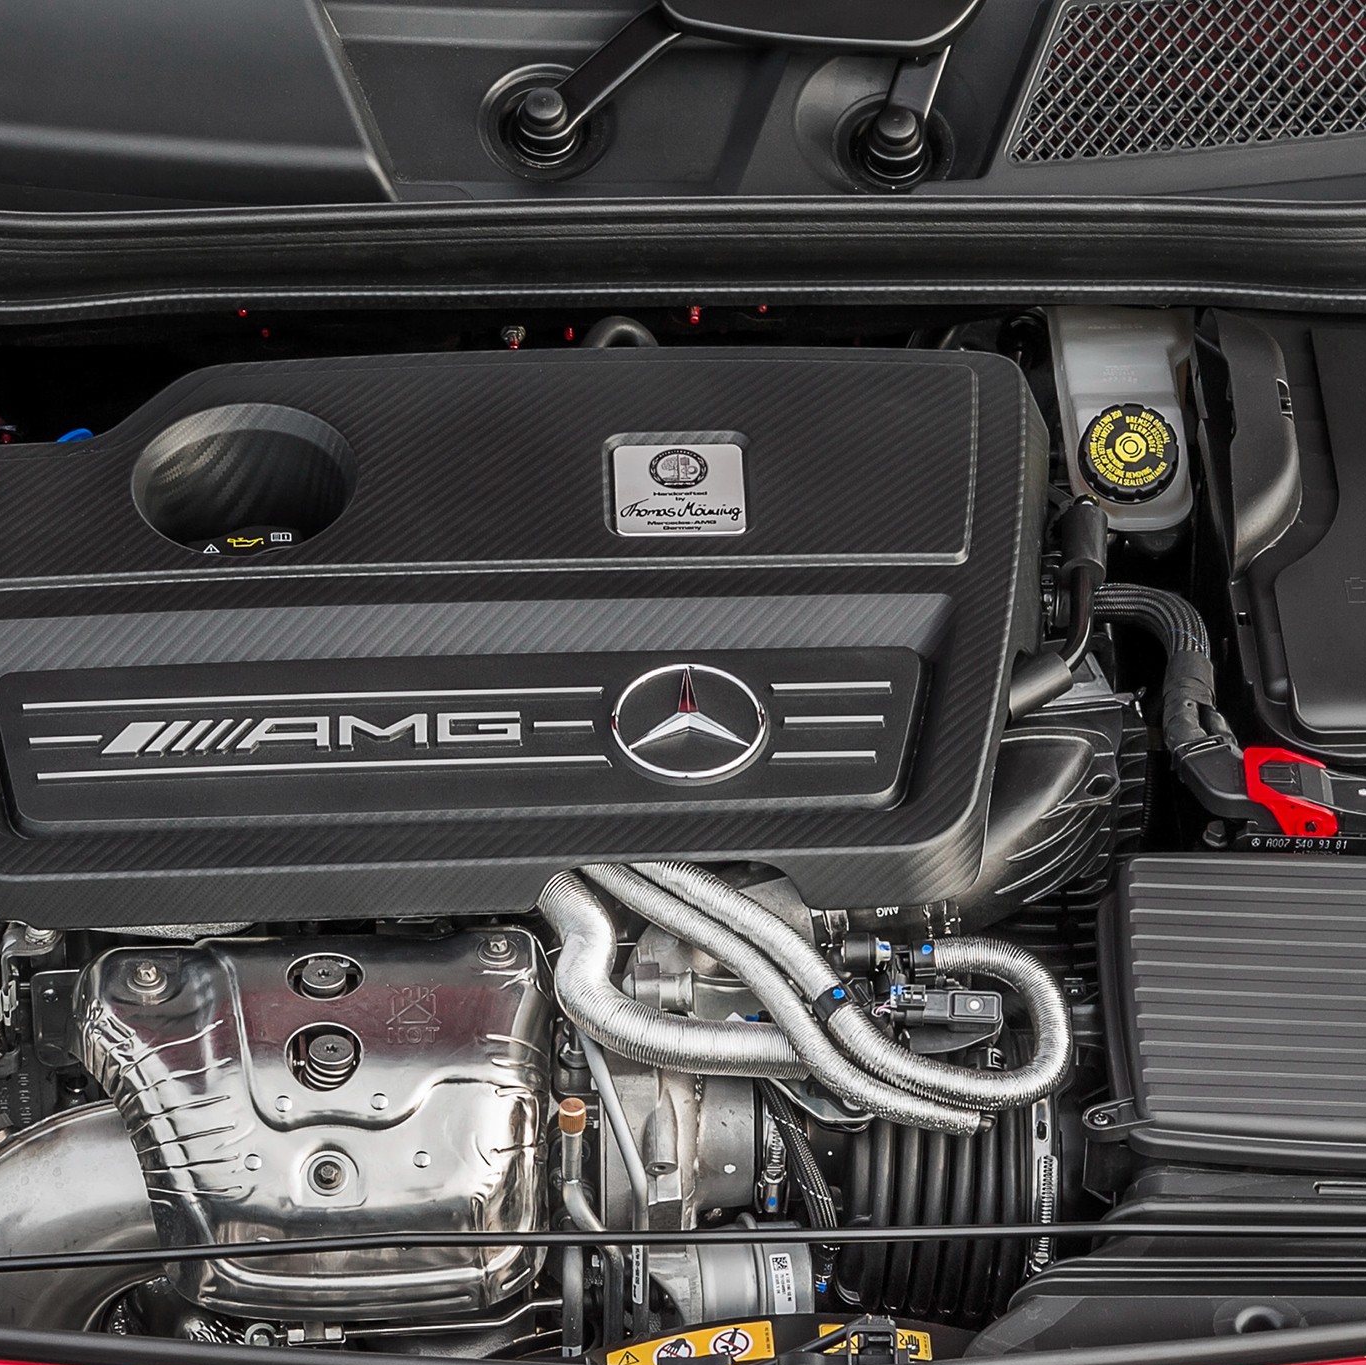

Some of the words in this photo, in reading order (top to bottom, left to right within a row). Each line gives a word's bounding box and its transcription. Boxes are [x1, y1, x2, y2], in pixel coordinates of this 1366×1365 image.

[620, 498, 676, 518] Thomas
[236, 711, 524, 754] AMG
[876, 906, 899, 917] AMG
[387, 1027, 440, 1043] HOT
